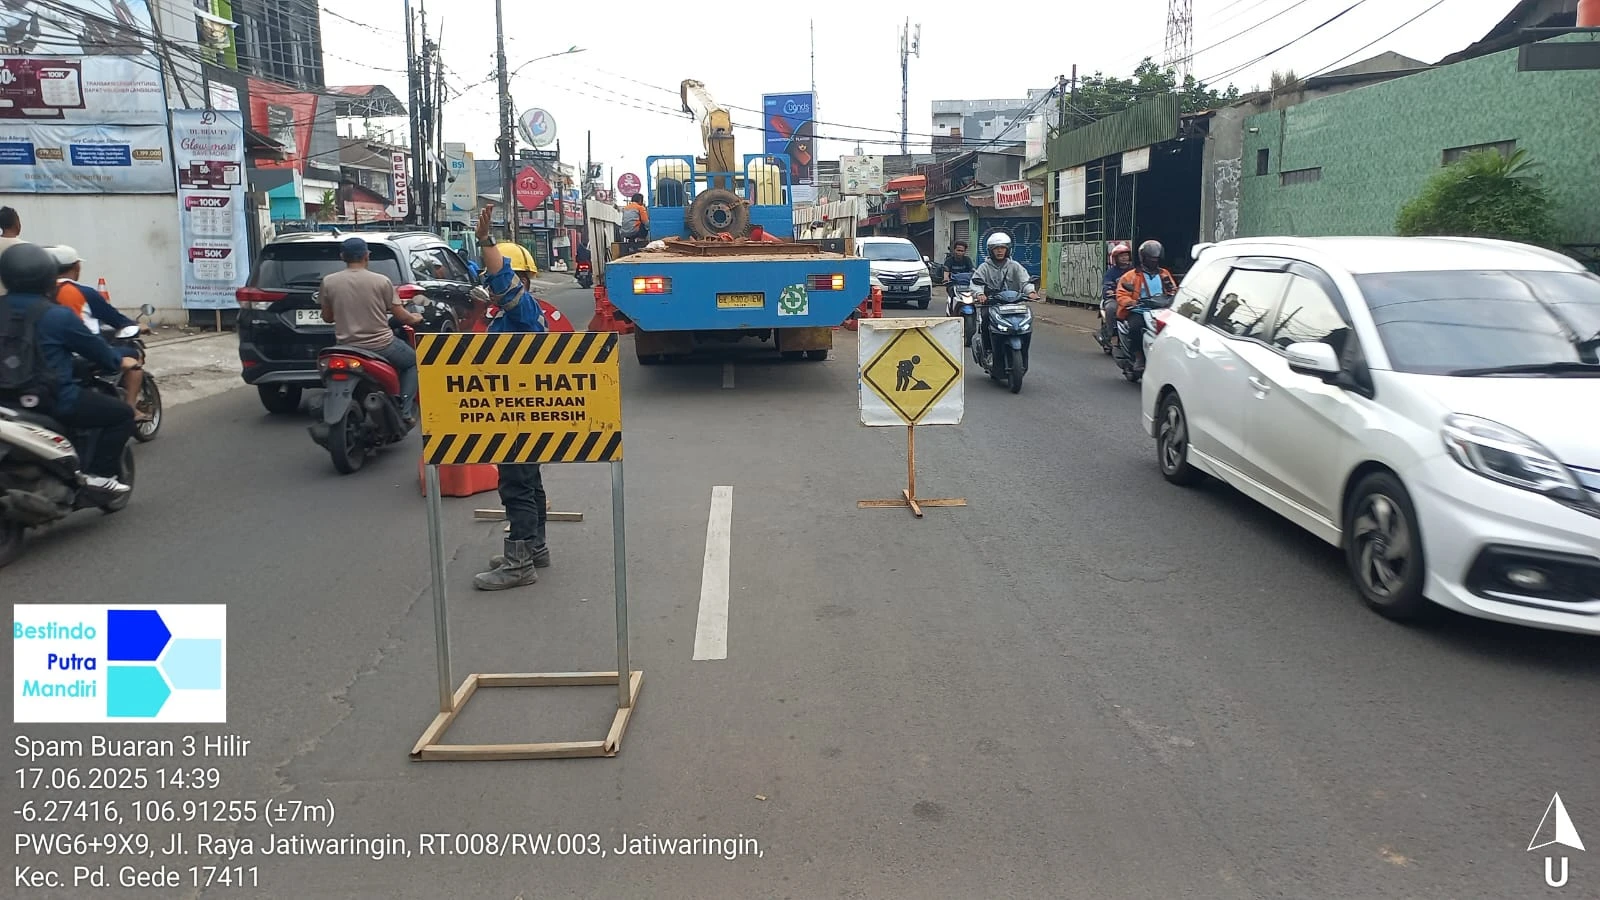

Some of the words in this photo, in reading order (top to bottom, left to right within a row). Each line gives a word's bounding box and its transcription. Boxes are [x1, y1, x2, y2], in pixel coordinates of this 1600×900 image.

[181, 138, 207, 150] Glow
[452, 161, 465, 169] BSI
[394, 156, 406, 213] BENGKEL
[200, 198, 221, 207] 100K
[204, 250, 223, 258] 50K
[297, 310, 303, 320] B
[446, 375, 510, 393] HATI
[535, 373, 597, 392] HATI
[459, 397, 491, 409] ADA
[495, 396, 585, 408] PEKERJAAN
[460, 412, 496, 423] PIPA
[500, 411, 526, 422] AIR
[530, 410, 586, 422] BERSIH
